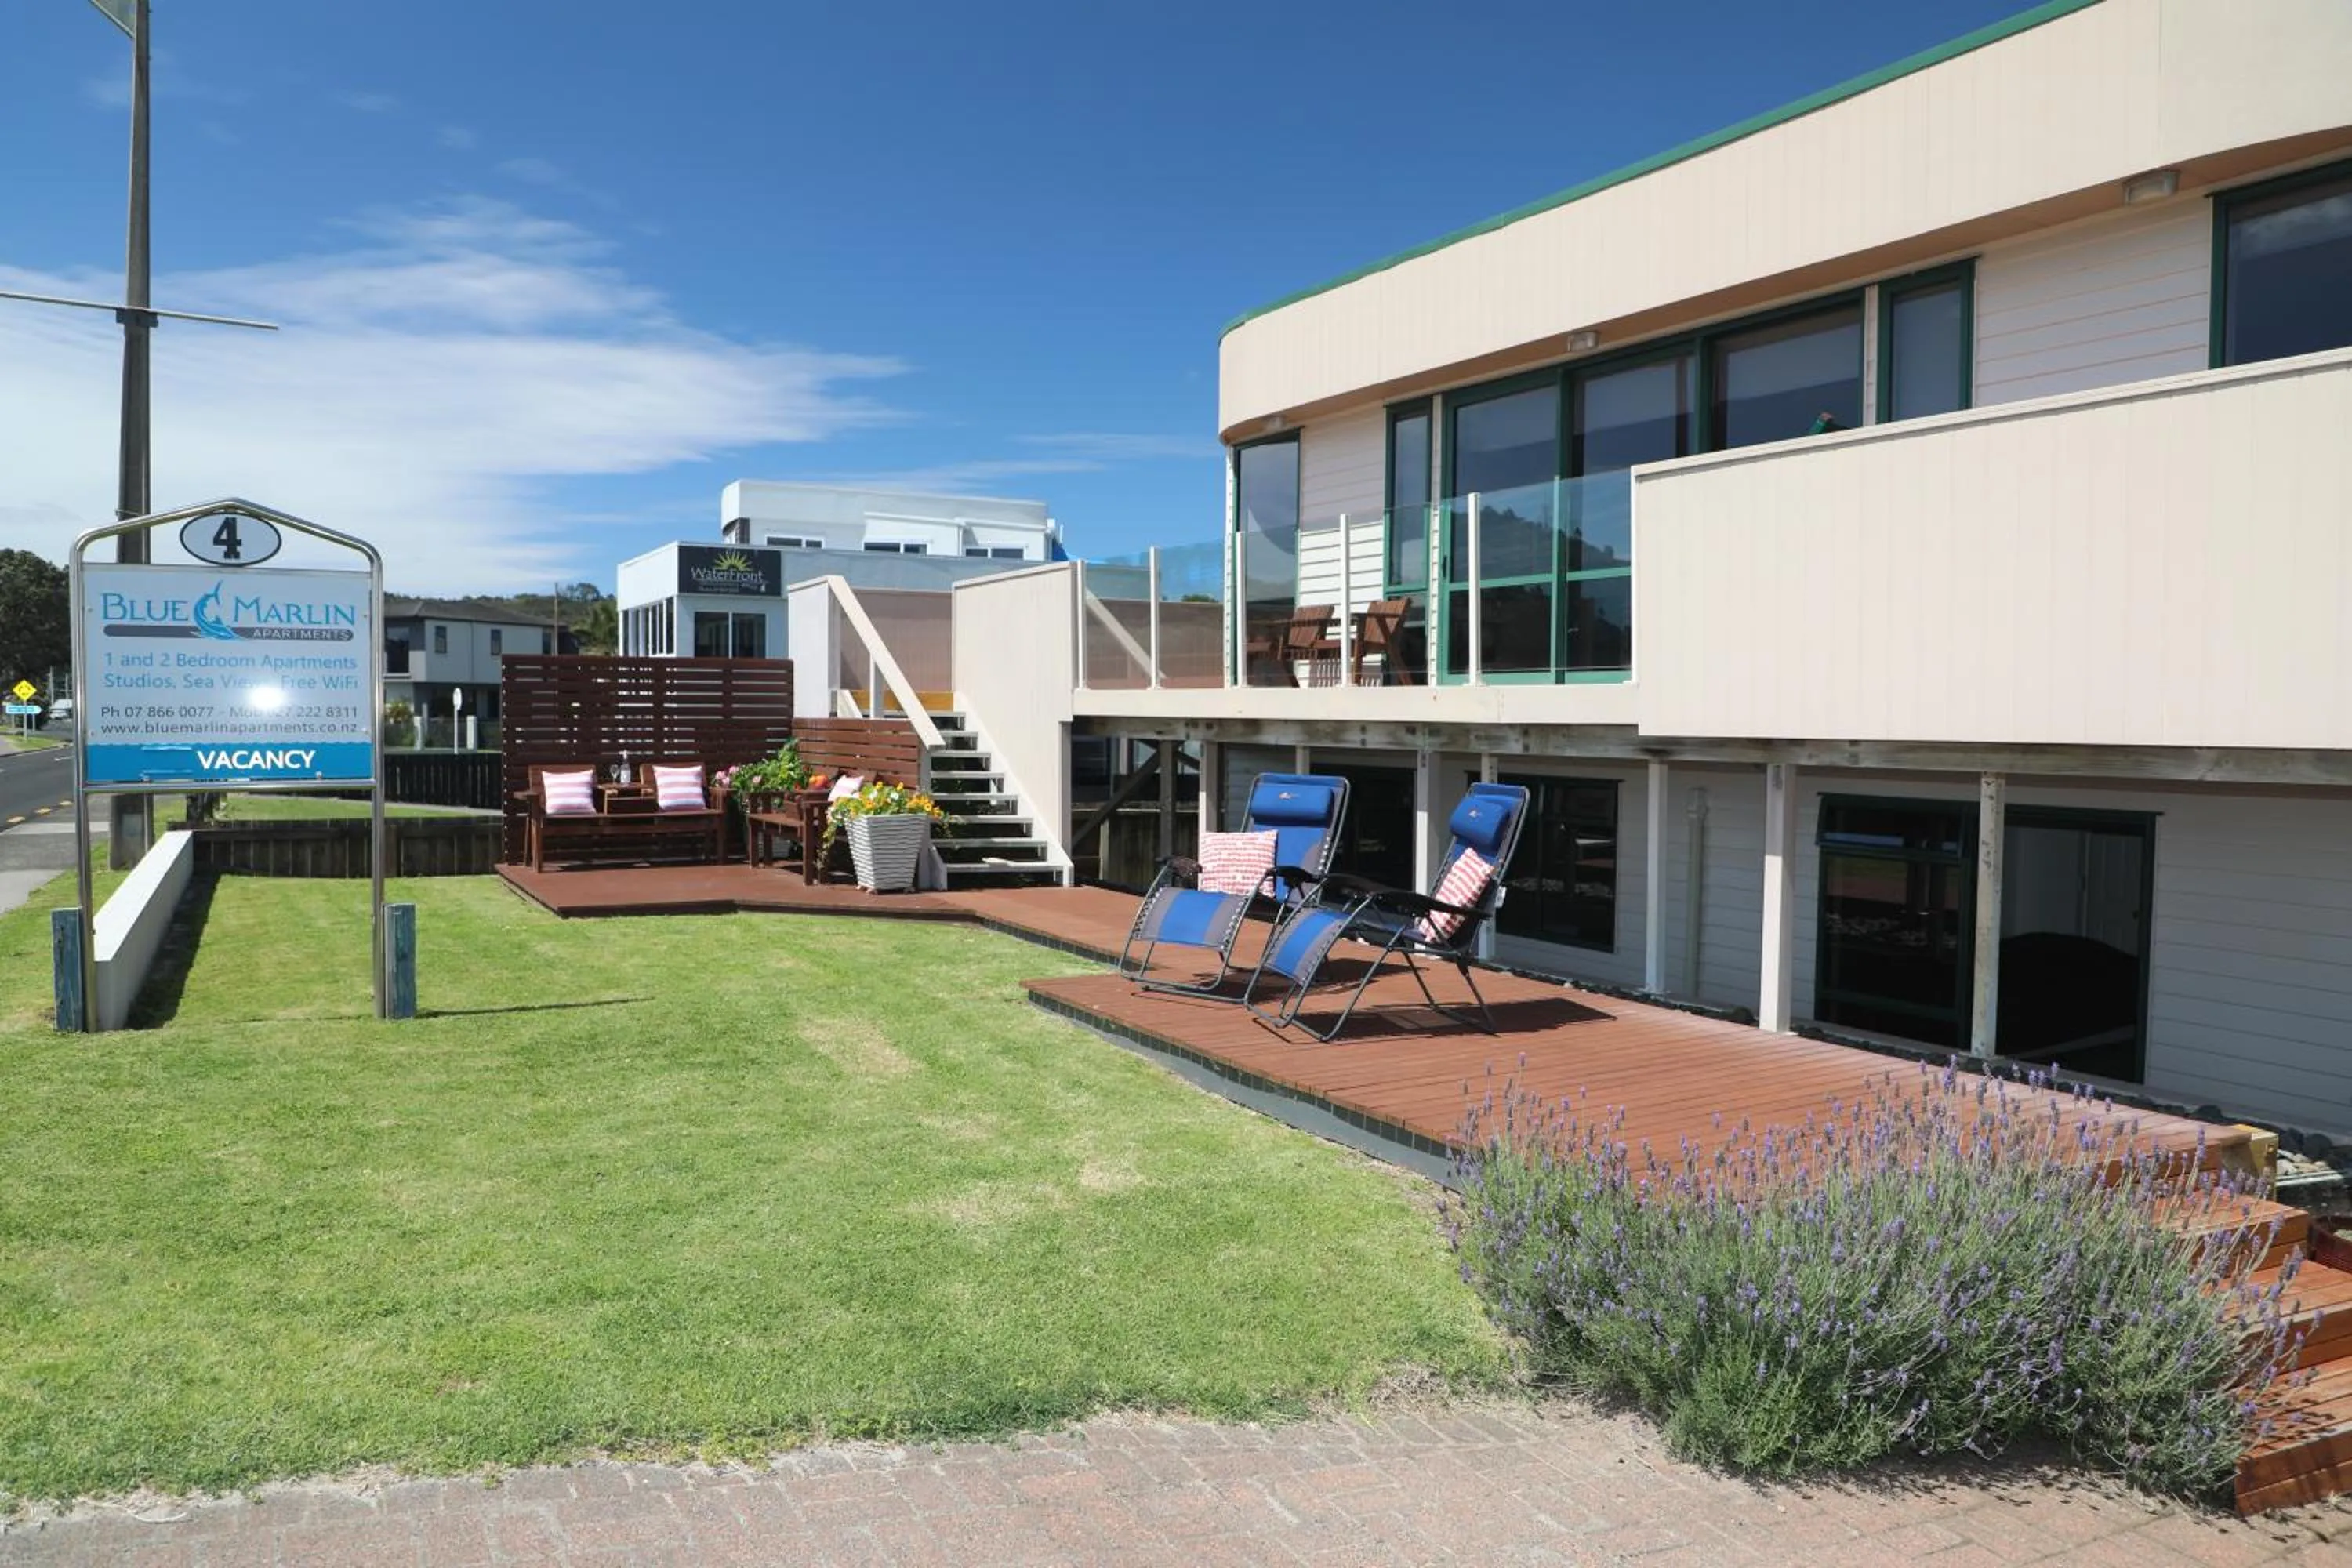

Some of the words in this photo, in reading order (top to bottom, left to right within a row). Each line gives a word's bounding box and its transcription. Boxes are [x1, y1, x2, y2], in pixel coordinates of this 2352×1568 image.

[212, 517, 241, 558] 4
[101, 592, 188, 622] BLUE
[234, 596, 356, 626] MARLIN
[252, 629, 350, 641] APARTMENTS
[104, 652, 112, 666] 1
[121, 652, 153, 666] and
[160, 653, 170, 666] 2
[176, 652, 255, 667] Bedroom
[261, 654, 358, 671] Apartments
[104, 673, 176, 688] Studios,
[183, 673, 214, 688] Sea
[281, 674, 317, 689] Free
[322, 675, 358, 689] WiFi
[100, 706, 119, 717] Ph
[125, 706, 143, 717] 07
[147, 706, 174, 717] 866
[179, 706, 214, 717] 0077
[296, 706, 321, 717] 222
[325, 706, 358, 717] 8311
[100, 721, 357, 735] www.bluemarlinapartments.co.nz
[196, 750, 316, 770] VACANCY
